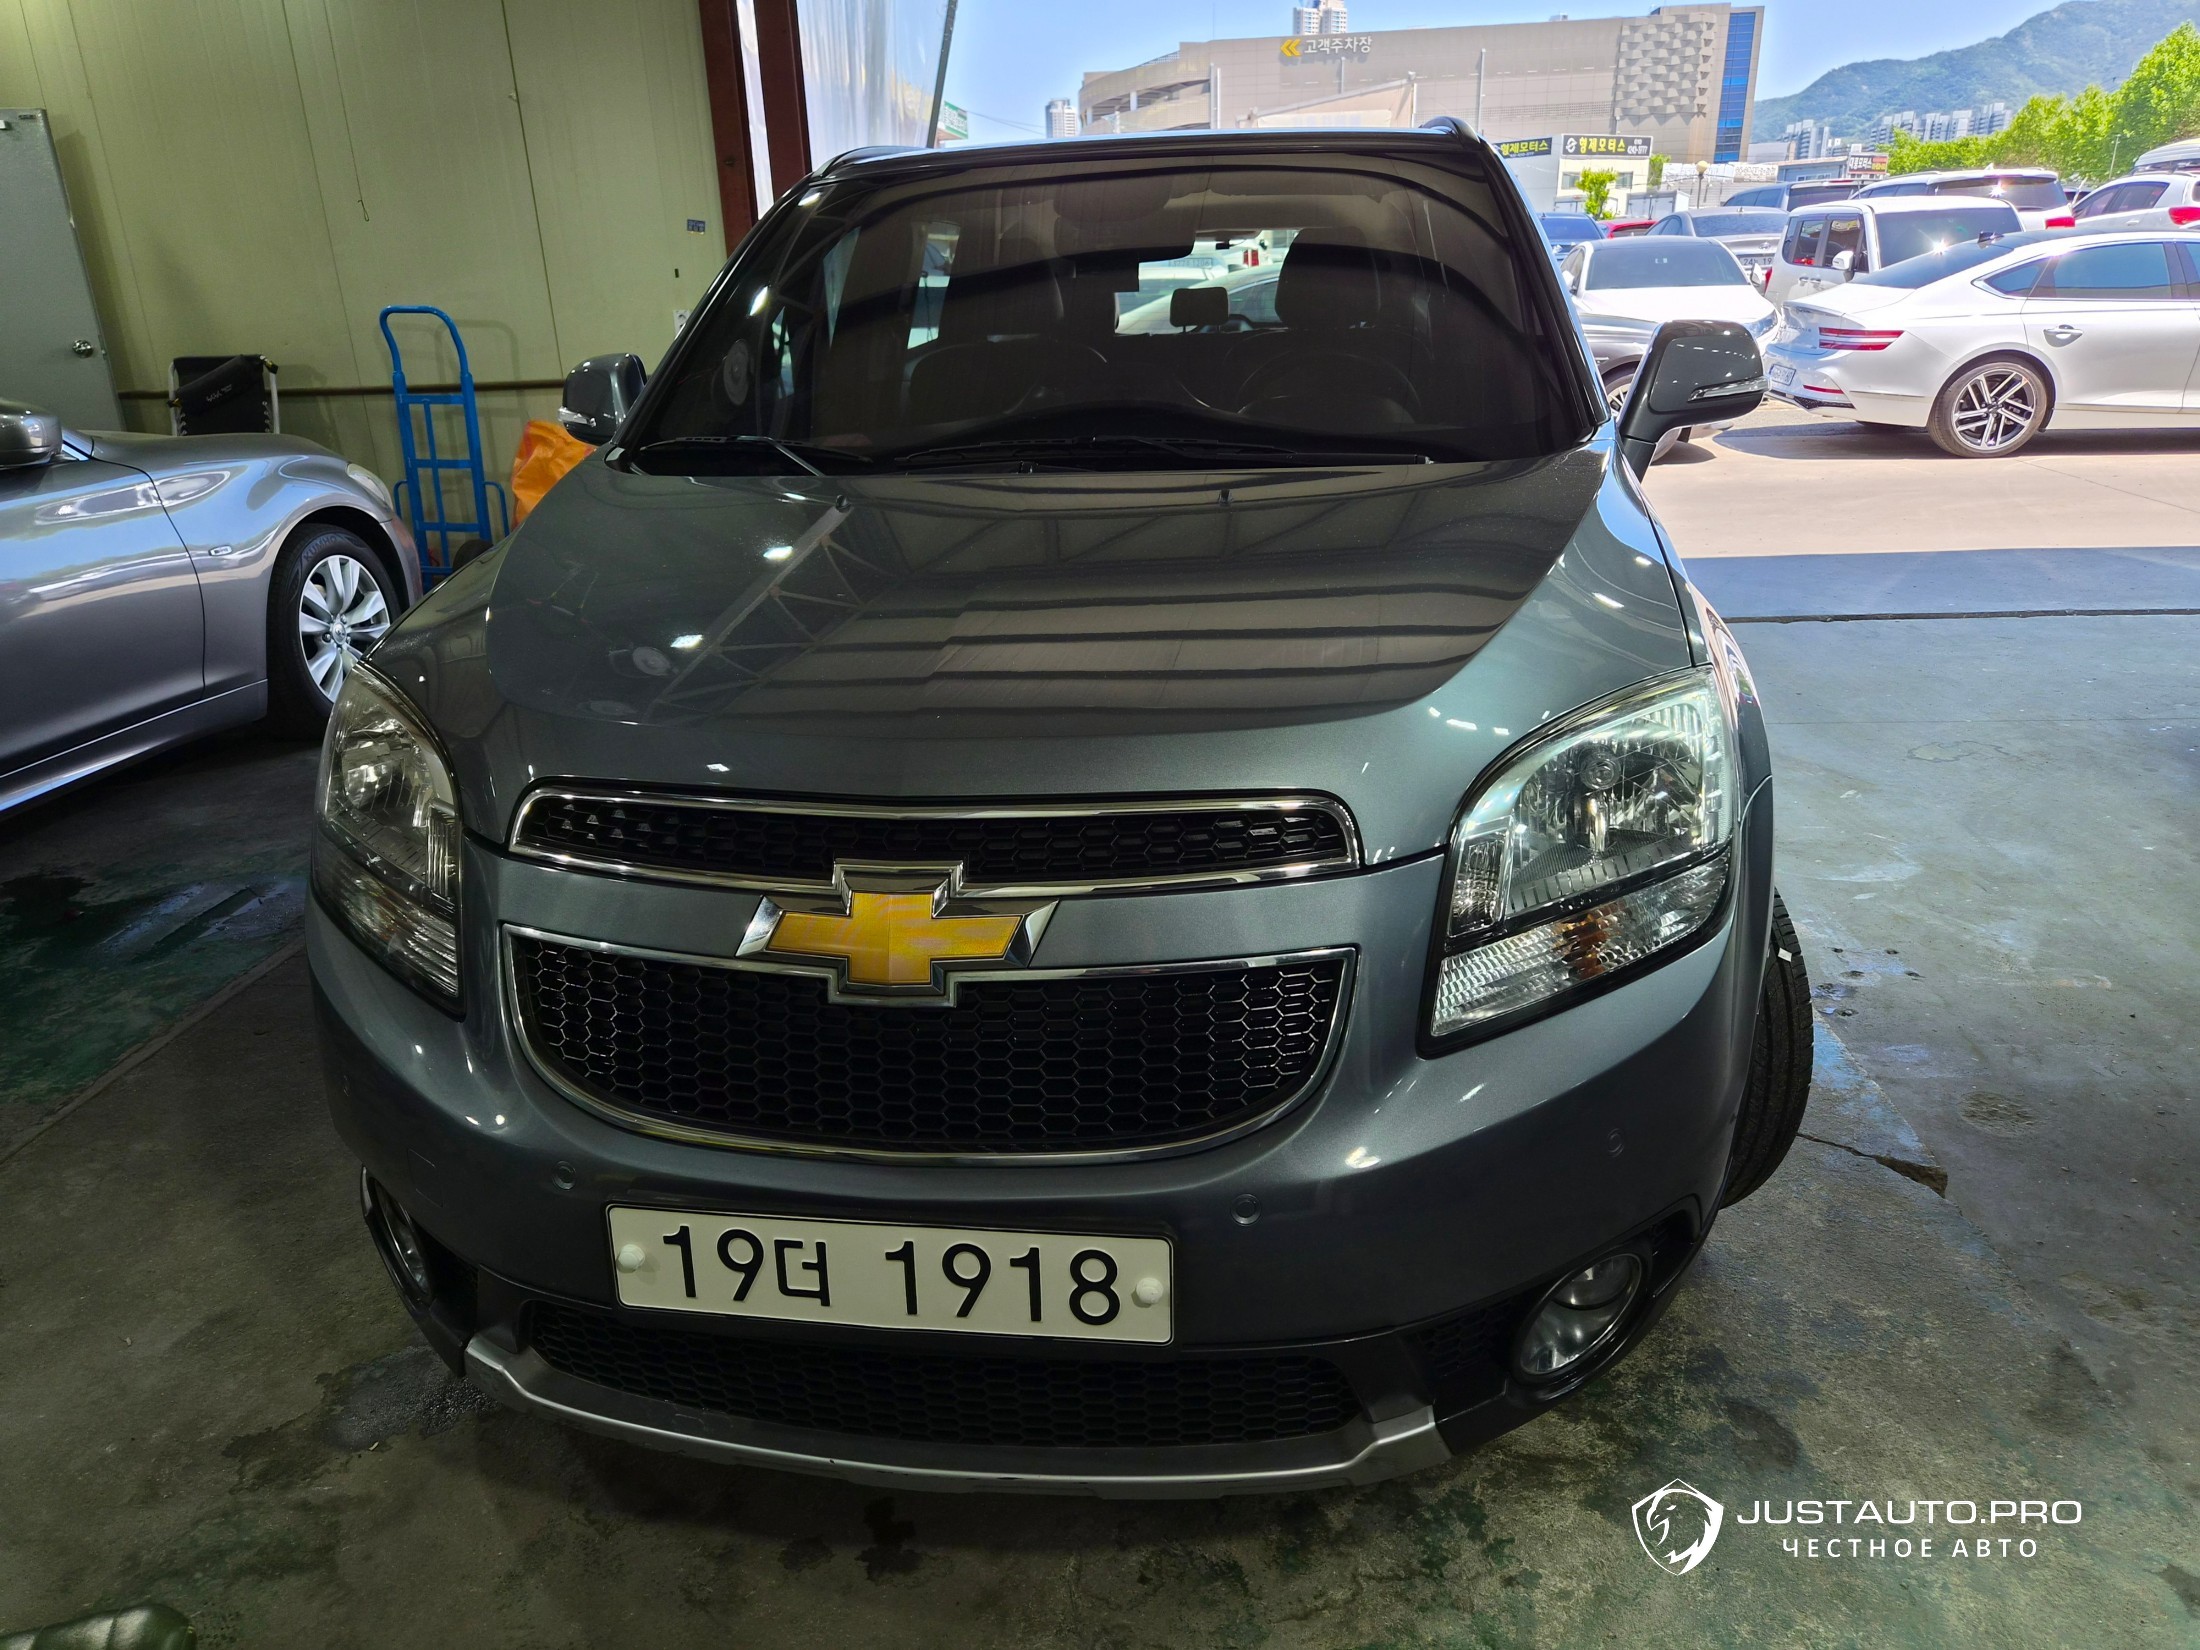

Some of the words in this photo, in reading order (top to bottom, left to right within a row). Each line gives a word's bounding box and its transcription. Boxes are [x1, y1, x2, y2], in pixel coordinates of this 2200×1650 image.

[1304, 36, 1373, 54] 고객주차장
[1500, 139, 1549, 156] 형제모터스
[1579, 136, 1626, 155] 형제모터스
[303, 535, 338, 561] KUMHO
[663, 1225, 831, 1307] 19더
[885, 1240, 1121, 1326] 1918
